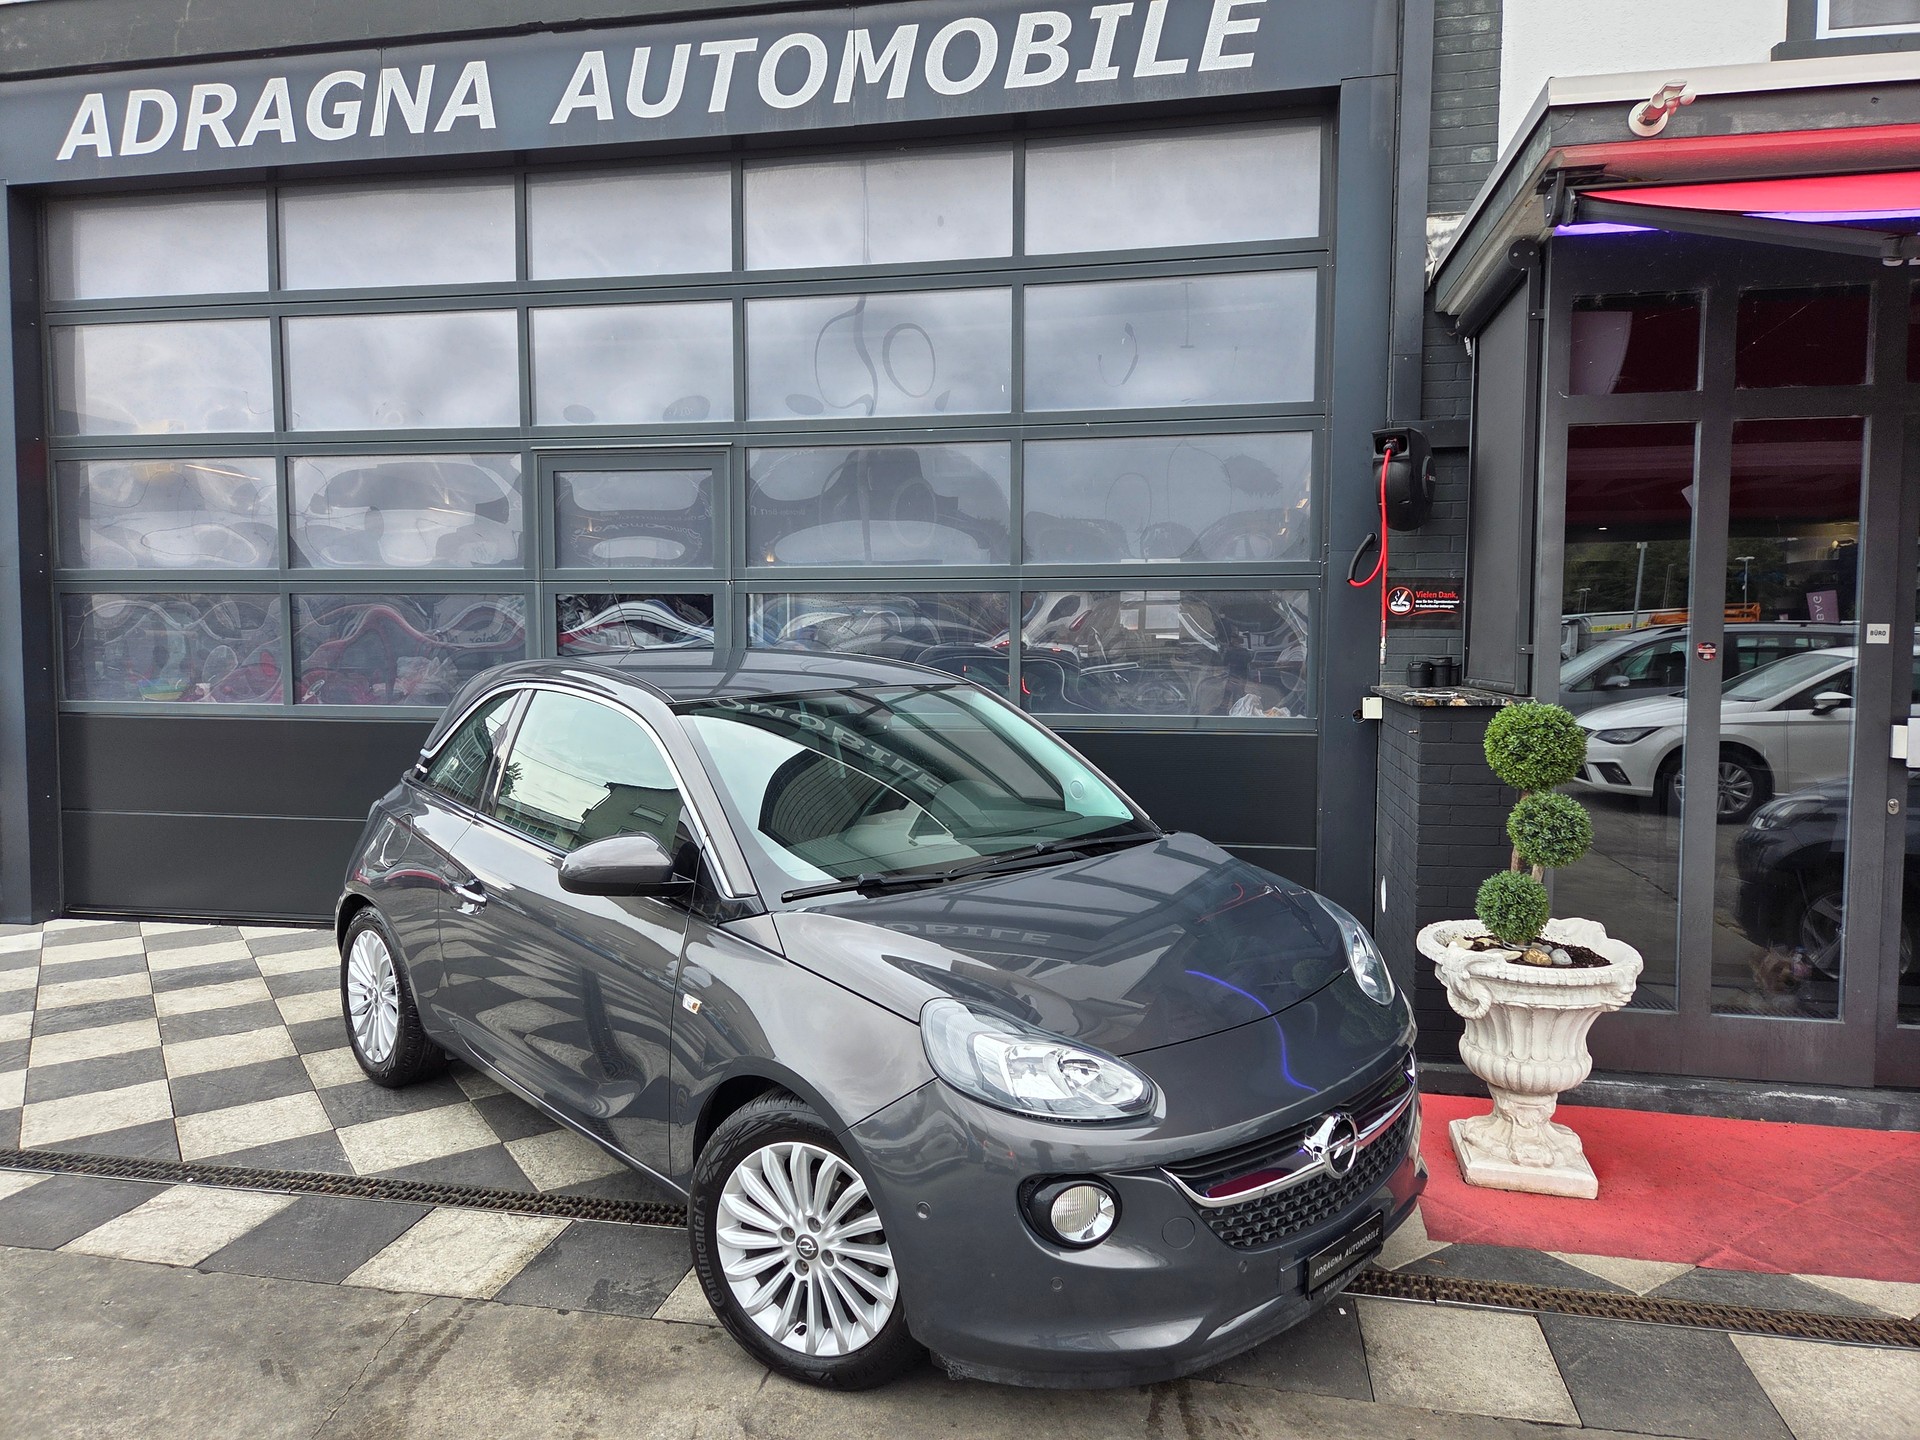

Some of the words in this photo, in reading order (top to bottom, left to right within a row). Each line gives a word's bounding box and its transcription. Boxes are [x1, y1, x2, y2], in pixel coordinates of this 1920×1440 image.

[56, 60, 497, 161] ADRAGNA
[549, 0, 1268, 125] AUTOMOBILE
[693, 1206, 725, 1308] Continental
[1313, 1254, 1342, 1278] ADRAGNA
[1344, 1228, 1379, 1257] AUTOMOBILE
